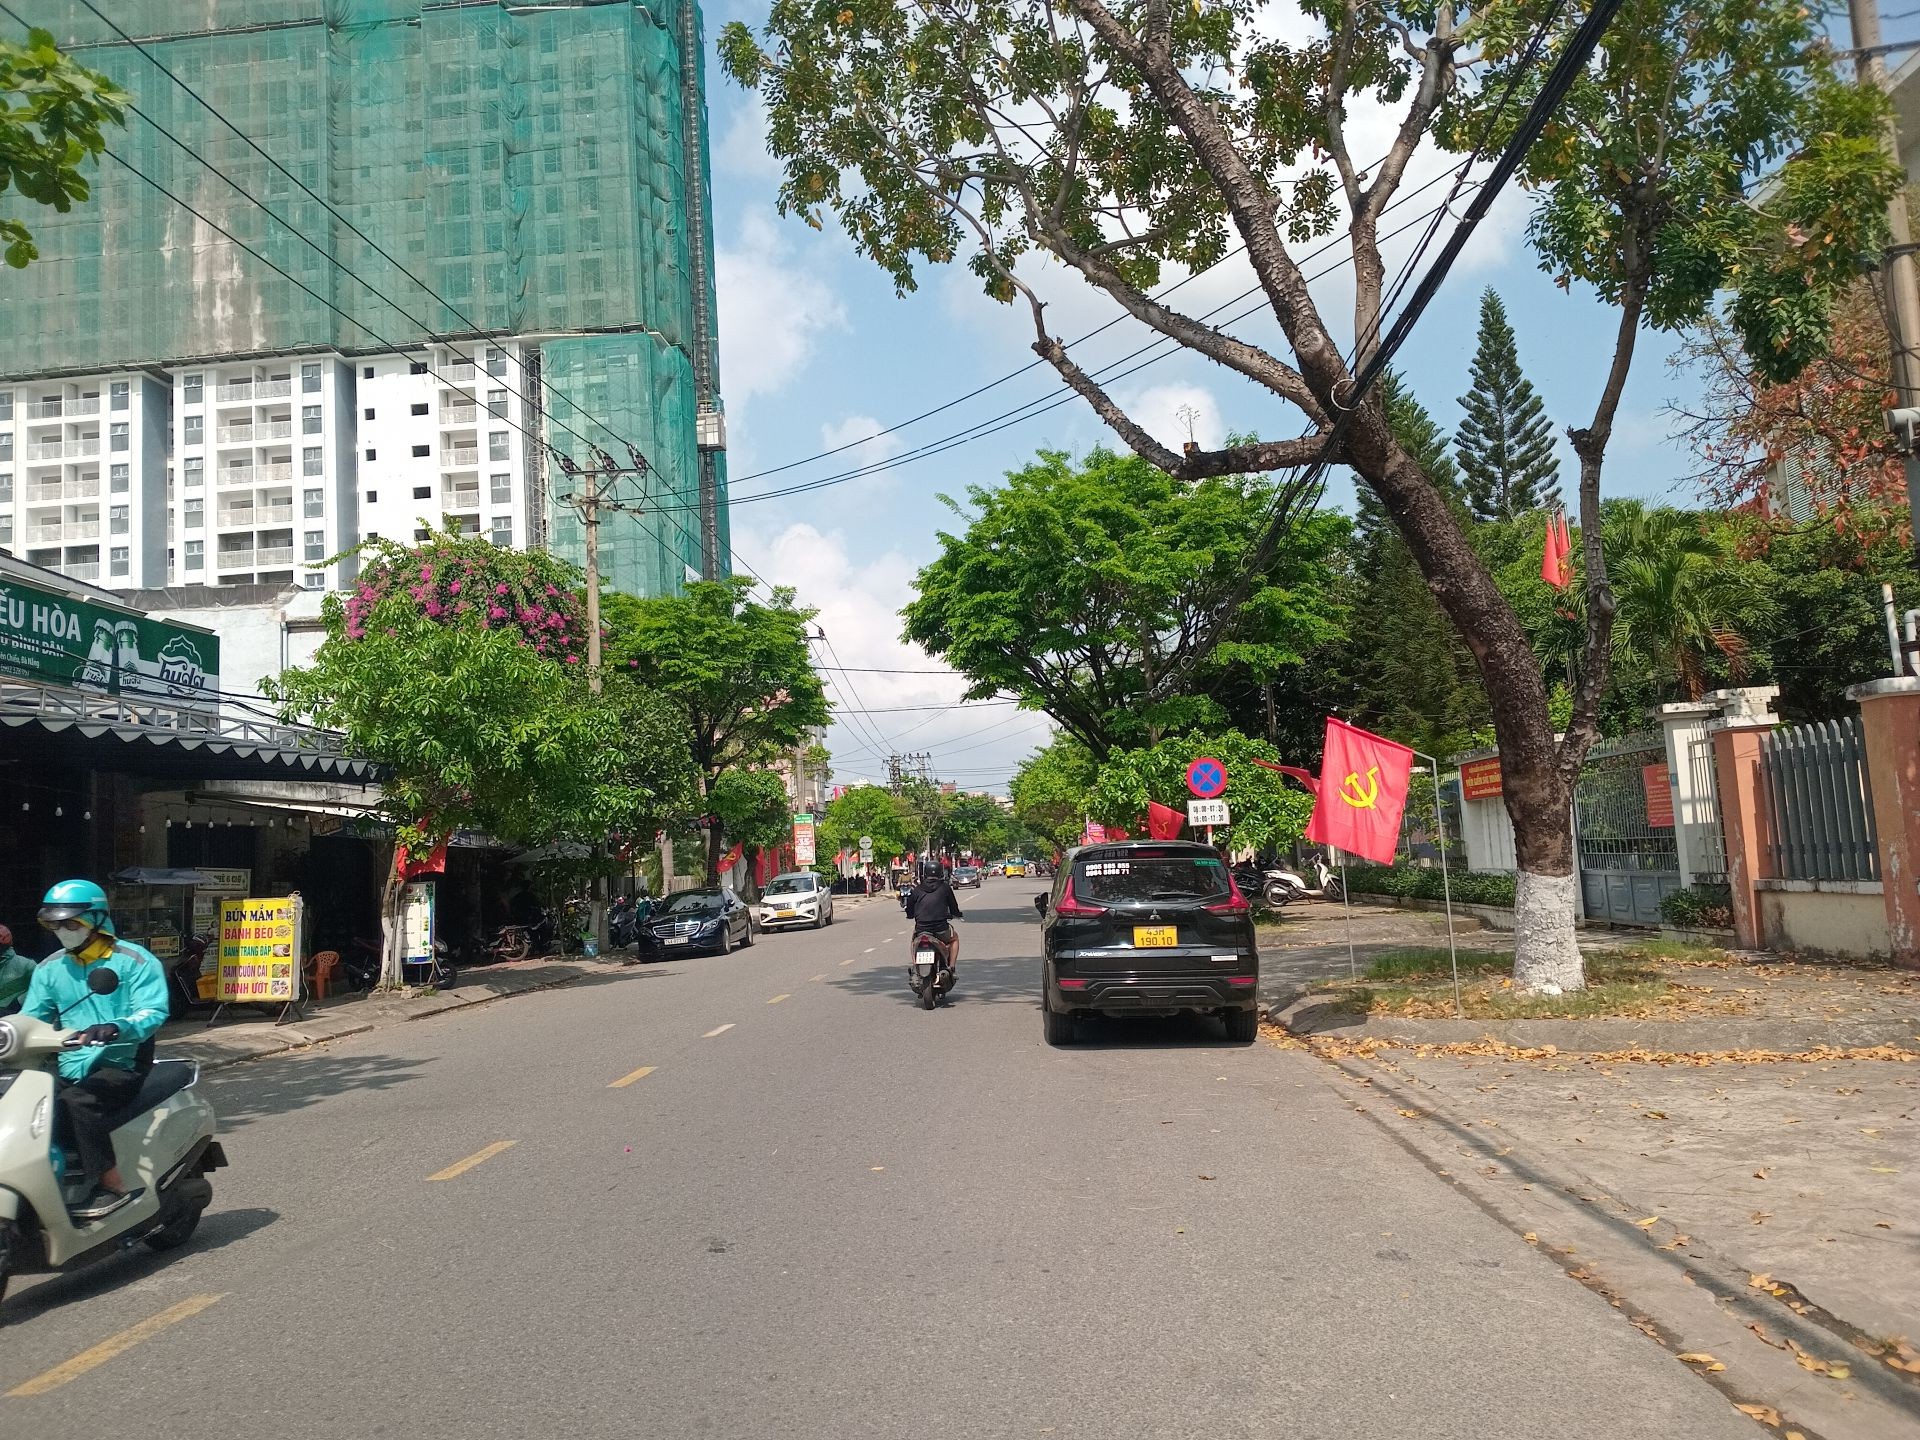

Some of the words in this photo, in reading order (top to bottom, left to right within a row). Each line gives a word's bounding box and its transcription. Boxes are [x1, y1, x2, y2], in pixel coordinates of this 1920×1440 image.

[32, 602, 82, 642] HÒA
[225, 908, 247, 922] BÚN
[250, 904, 274, 921] MẮM
[224, 926, 251, 940] BÁNH
[1140, 936, 1173, 946] 190.10
